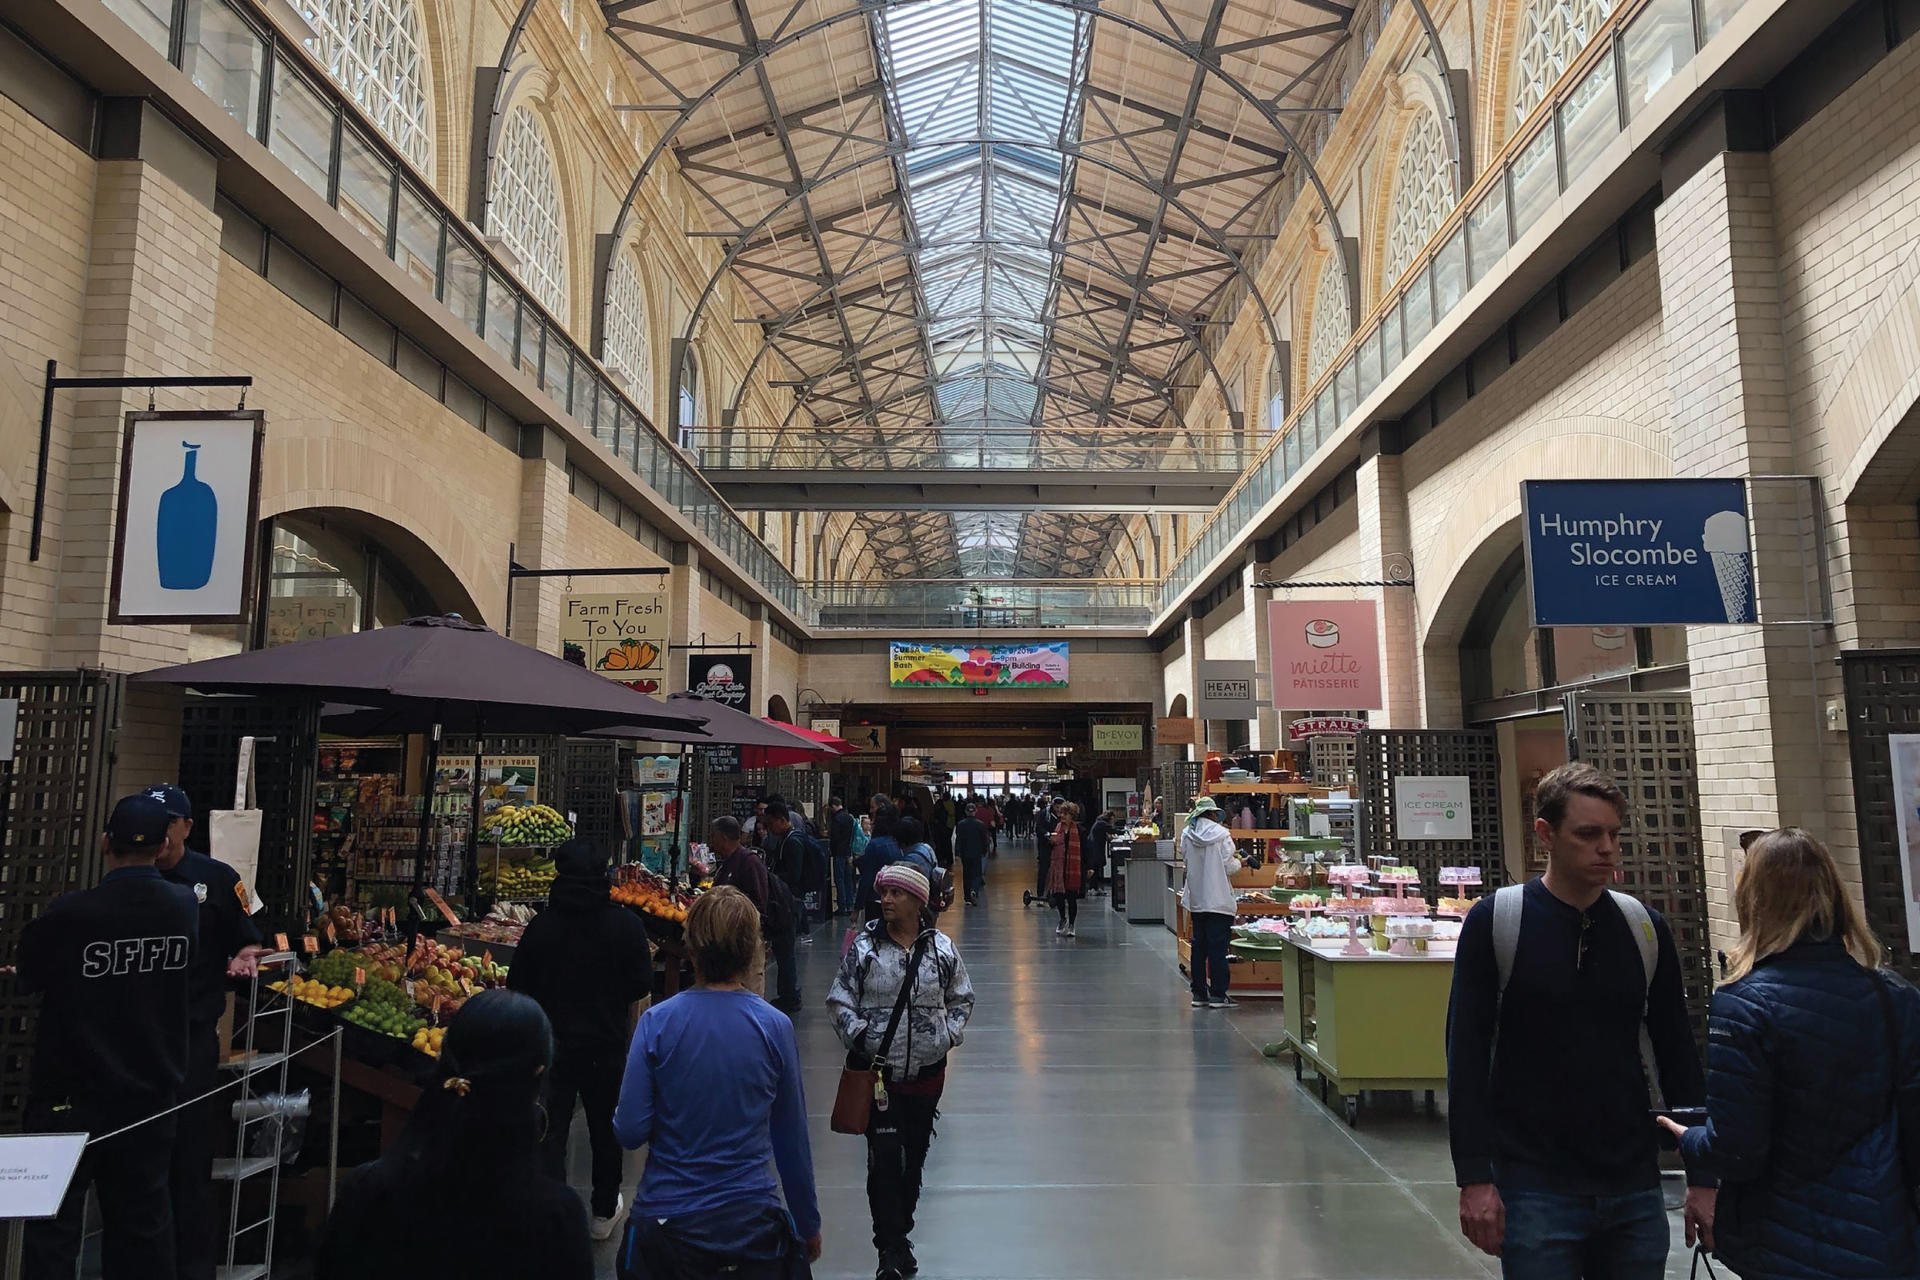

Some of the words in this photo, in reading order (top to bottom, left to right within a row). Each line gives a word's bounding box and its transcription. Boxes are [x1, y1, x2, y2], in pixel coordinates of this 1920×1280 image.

[1540, 513, 1662, 543] Humphry
[1570, 542, 1698, 566] Slocombe
[1595, 575, 1619, 586] ICE
[1625, 575, 1677, 586] CREAM
[568, 600, 609, 617] Farm
[616, 597, 663, 616] Fresh
[582, 620, 607, 637] To
[613, 619, 646, 636] You
[893, 646, 921, 654] CUESA
[893, 654, 925, 662] Summer
[1290, 652, 1362, 675] miette
[1012, 662, 1041, 670] Building
[1207, 683, 1247, 691] HEATH
[1297, 720, 1359, 732] STRAUS
[1404, 801, 1421, 809] ICE
[1424, 801, 1463, 809] CREAM
[82, 935, 190, 978] SFFD
